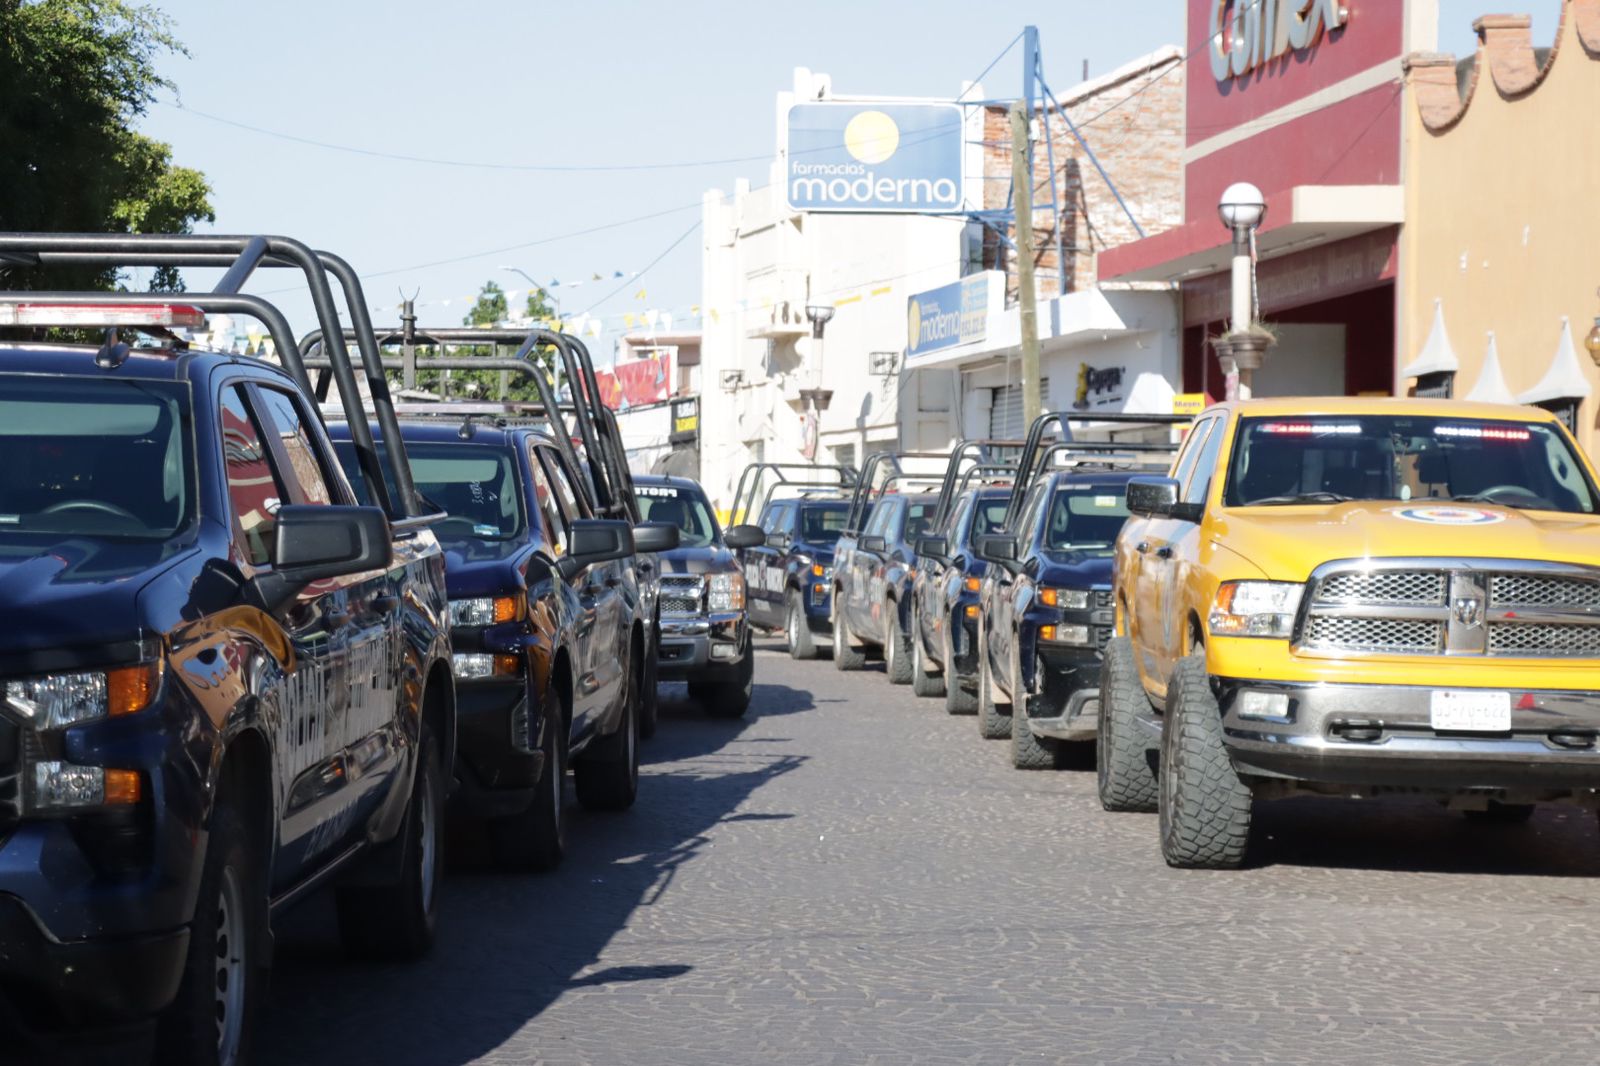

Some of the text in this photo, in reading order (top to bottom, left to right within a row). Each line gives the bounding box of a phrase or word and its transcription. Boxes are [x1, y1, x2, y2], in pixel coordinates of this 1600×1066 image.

[791, 161, 865, 175] farmacias
[791, 172, 957, 203] moderna
[920, 311, 960, 344] moderna
